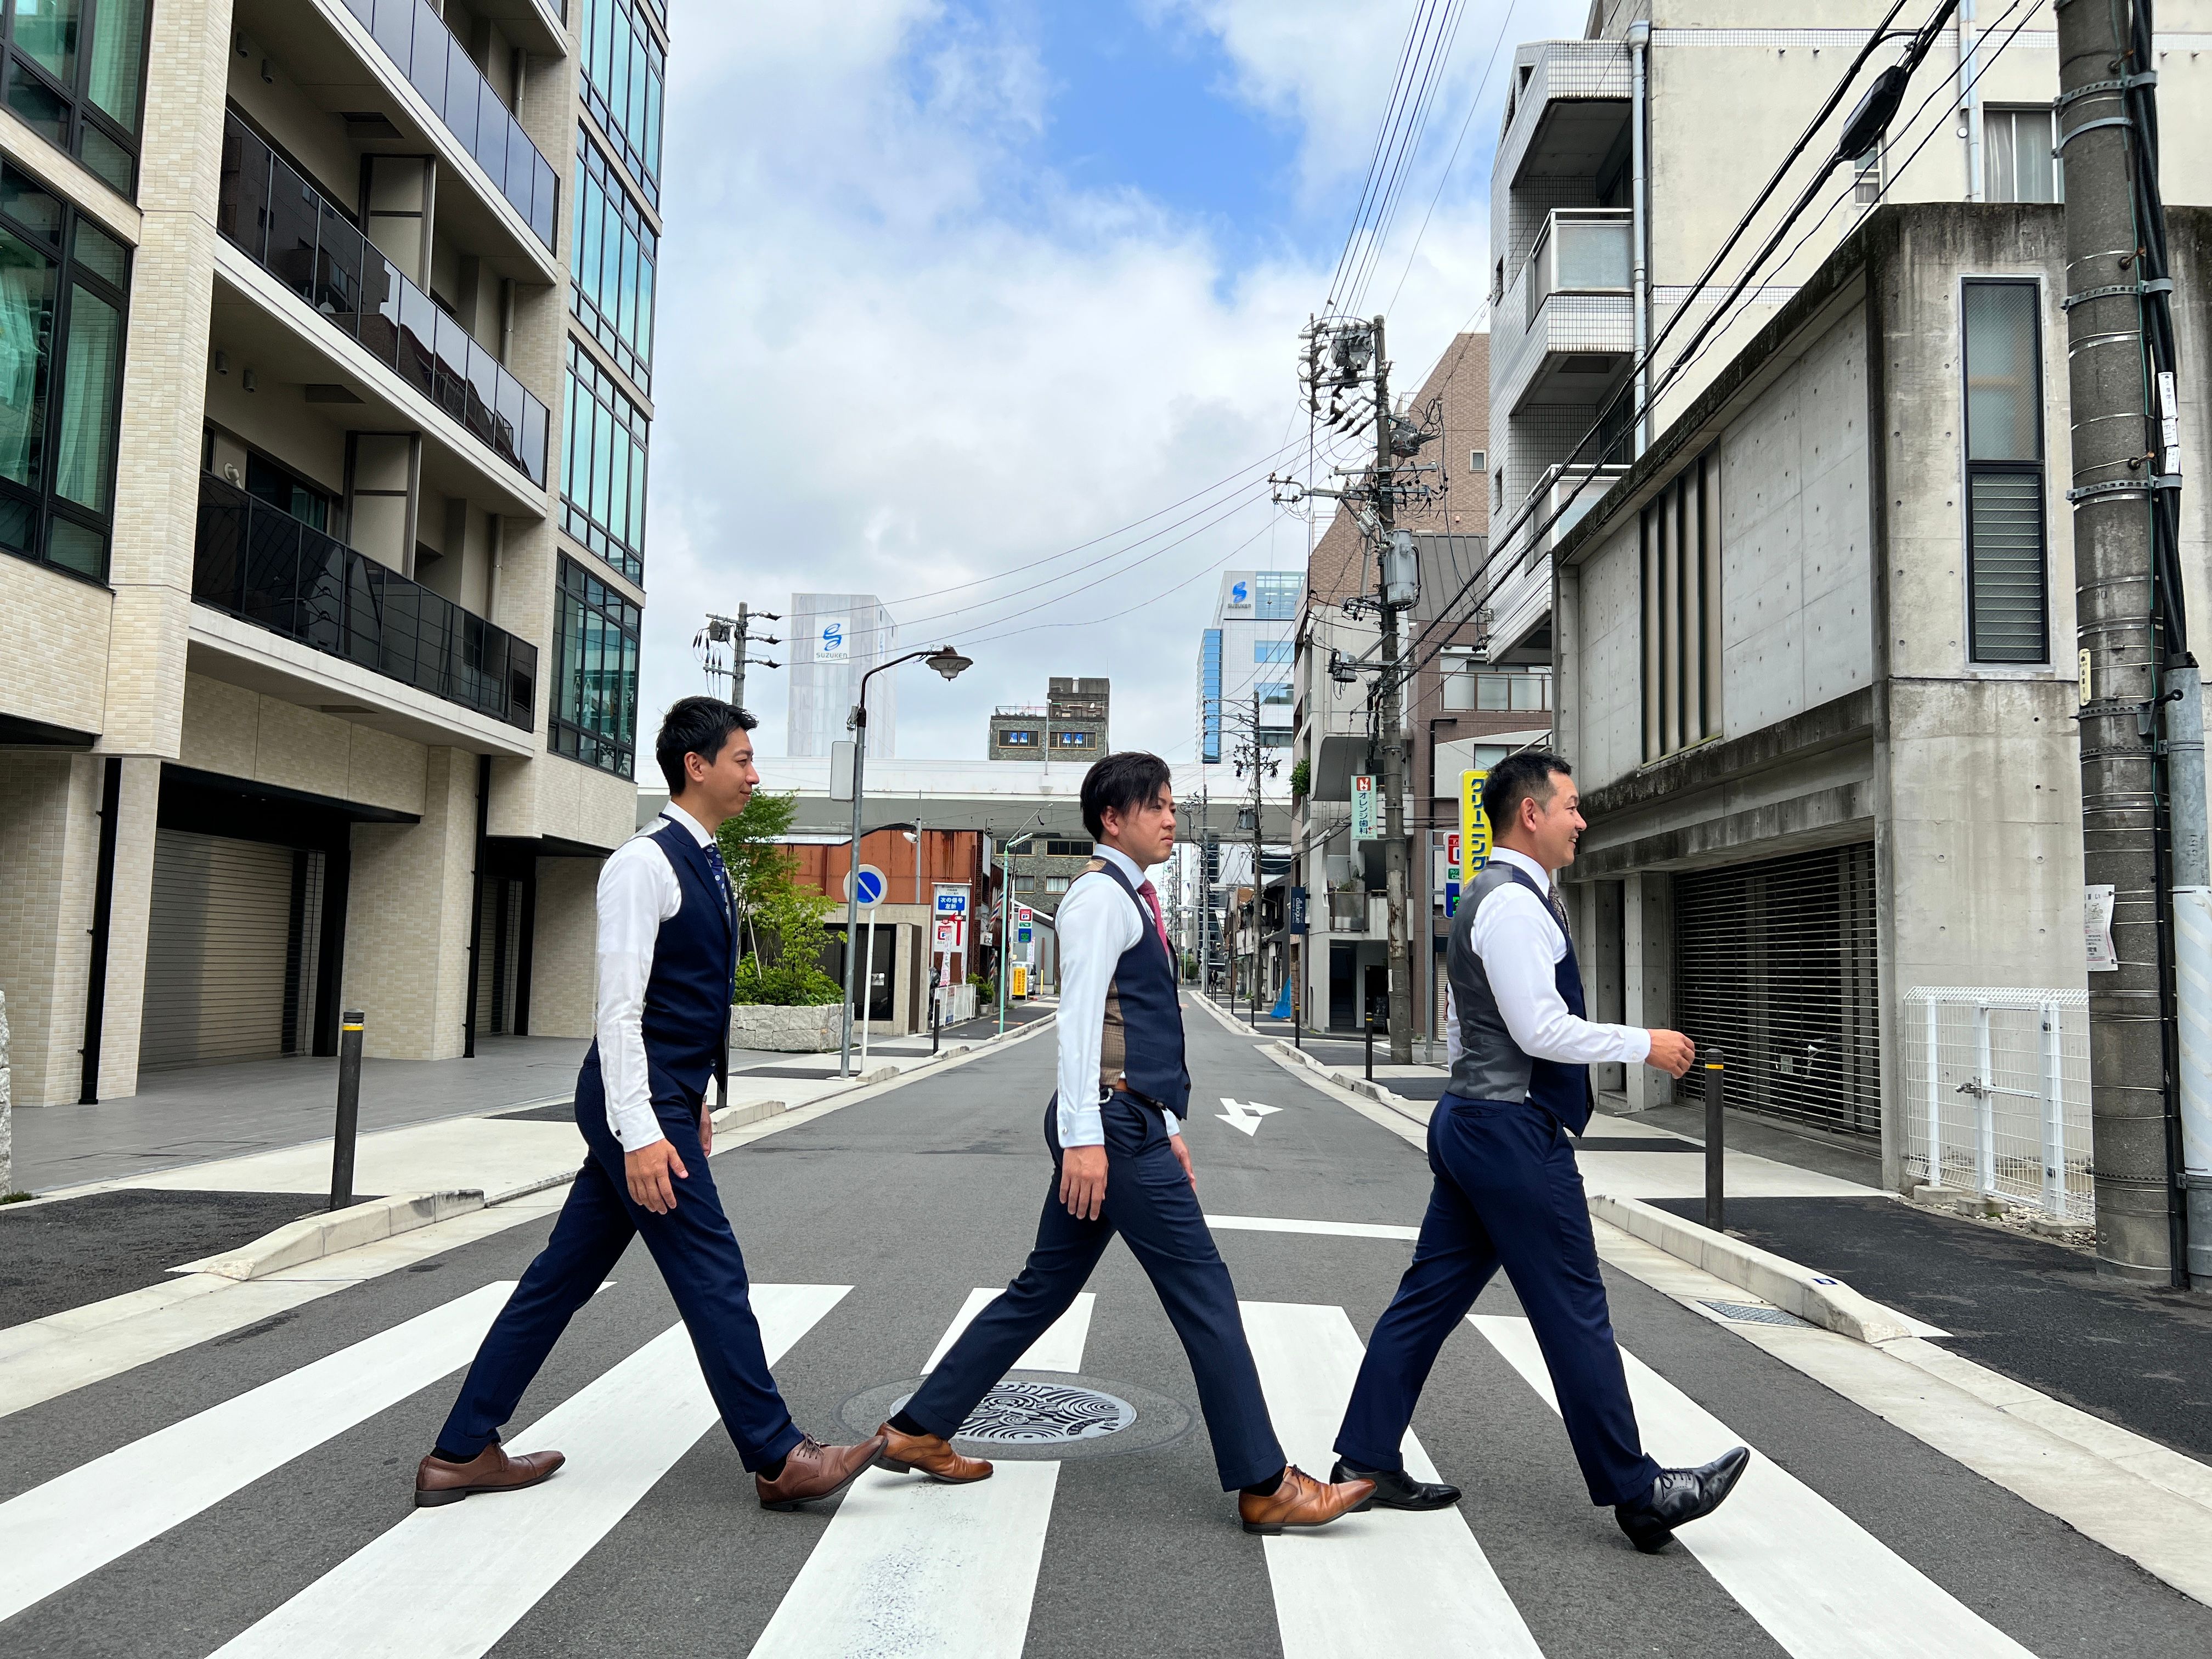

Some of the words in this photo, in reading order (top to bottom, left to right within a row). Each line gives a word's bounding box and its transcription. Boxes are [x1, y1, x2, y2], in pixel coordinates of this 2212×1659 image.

[1358, 792, 1368, 834] オレンジ歯科
[1471, 778, 1487, 871] クリーニング
[1295, 898, 1303, 923] dialogue
